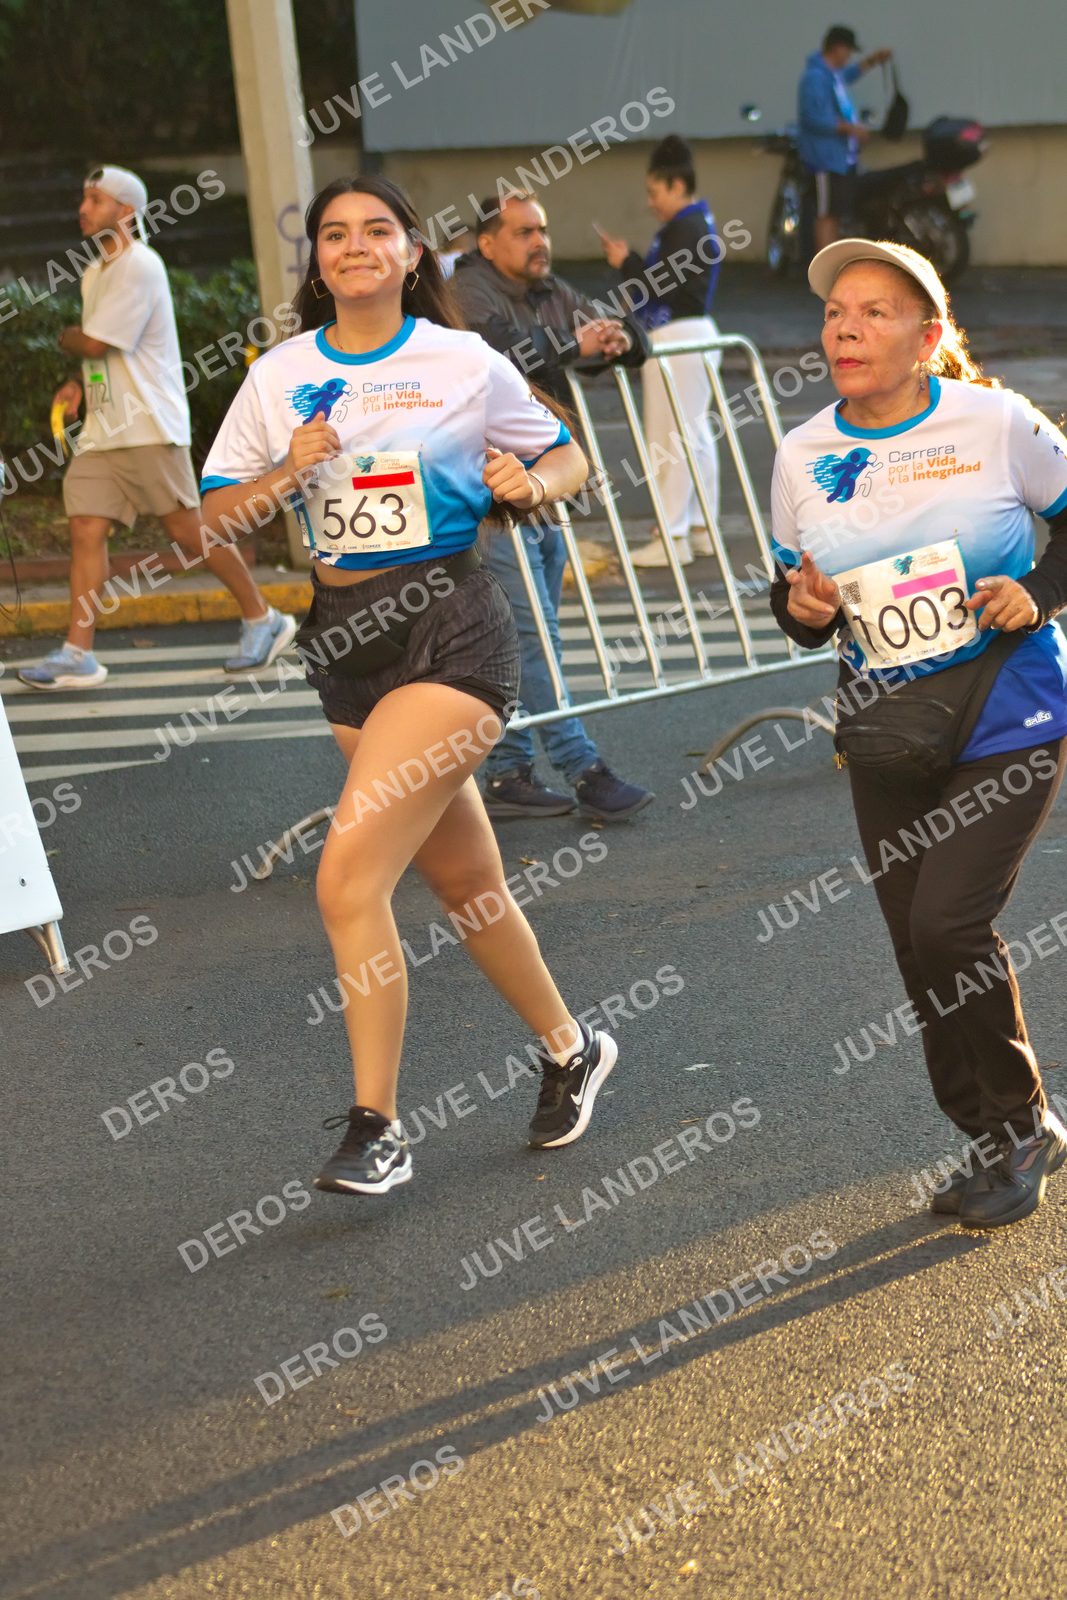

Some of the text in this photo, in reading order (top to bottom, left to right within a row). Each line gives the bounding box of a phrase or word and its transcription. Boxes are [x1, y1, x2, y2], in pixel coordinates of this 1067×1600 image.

[362, 381, 421, 394] Carrera
[362, 390, 422, 407] por la Vida
[362, 399, 443, 416] y la Integridad
[888, 444, 955, 463] Carrera
[888, 455, 957, 477] por la Vida
[888, 461, 981, 487] y la Integridad
[323, 493, 407, 540] 563
[852, 587, 969, 654] 1003
